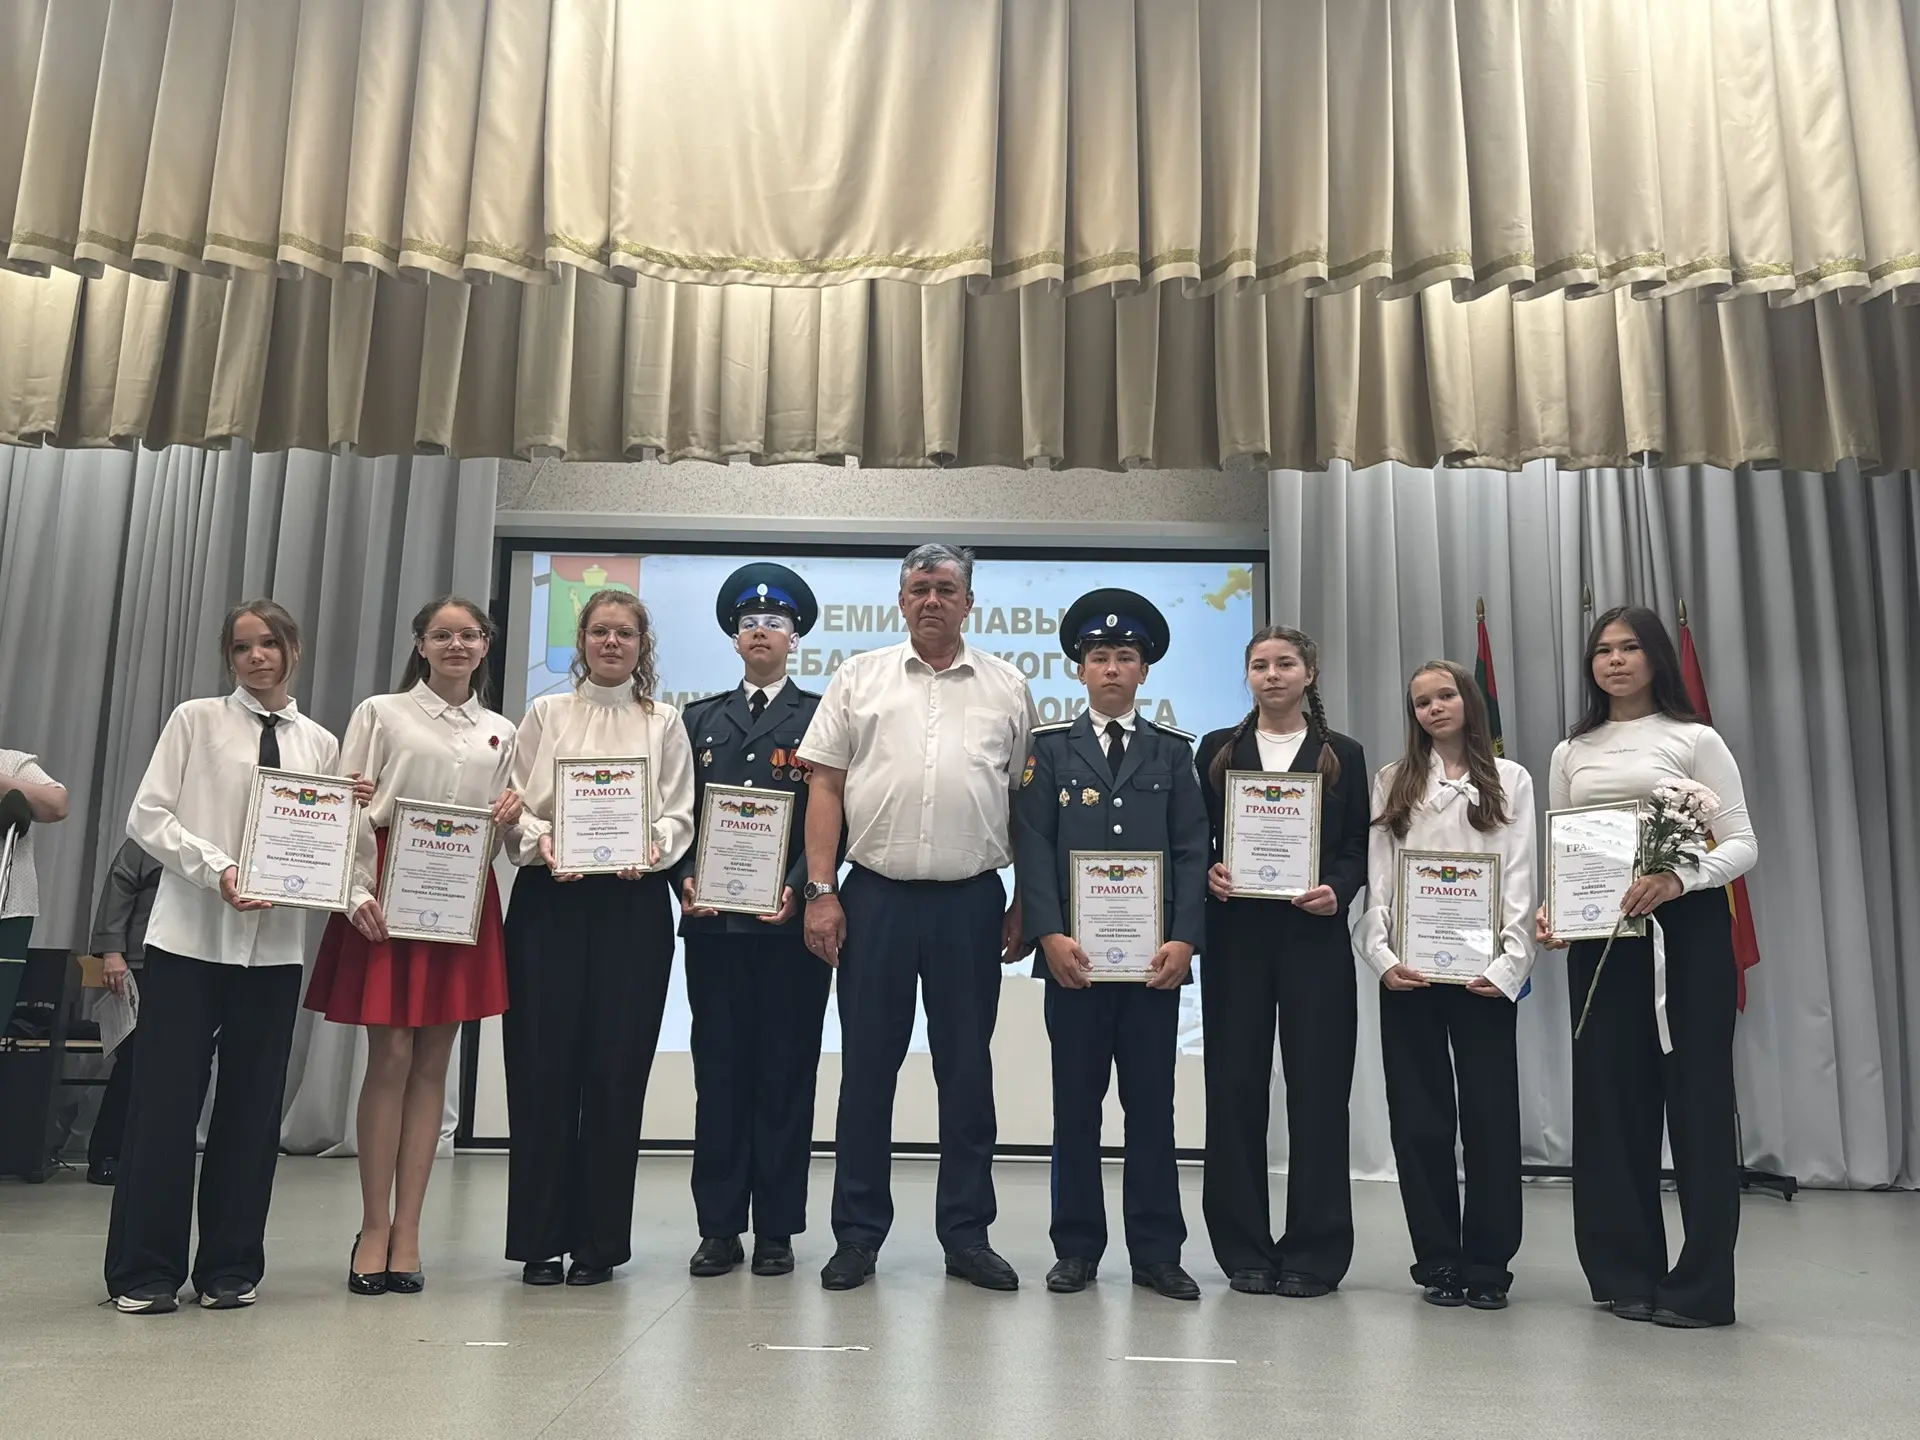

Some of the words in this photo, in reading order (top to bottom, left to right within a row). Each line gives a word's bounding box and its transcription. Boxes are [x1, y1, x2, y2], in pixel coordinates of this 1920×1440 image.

[961, 606, 1067, 634] ЛАВЫ
[575, 787, 631, 797] ГРАМОТА
[273, 805, 337, 822] ГРАМОТА
[1245, 805, 1300, 815] ГРАМОТА
[720, 820, 772, 832] ГРАМОТА
[411, 838, 471, 853] ГРАМОТА
[1090, 885, 1144, 894] ГРАМОТА
[1420, 885, 1478, 897] ГРАМОТА
